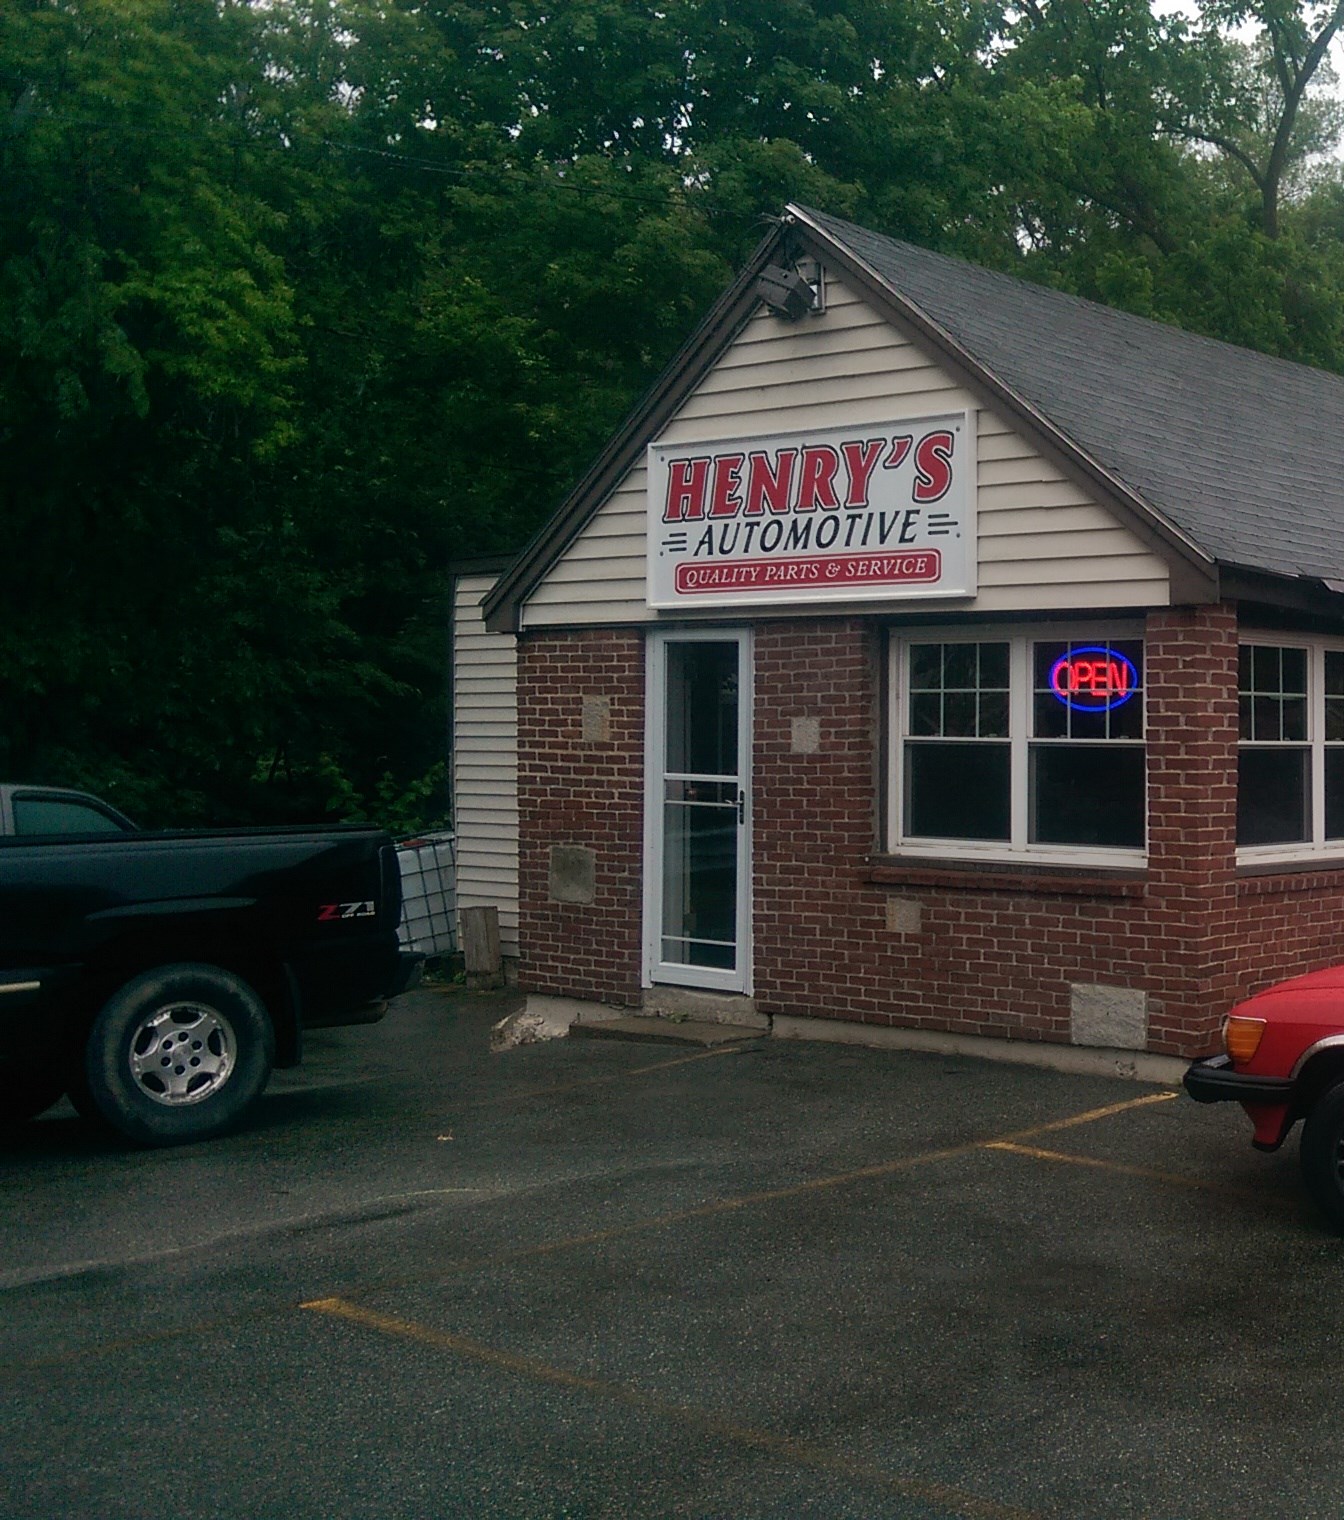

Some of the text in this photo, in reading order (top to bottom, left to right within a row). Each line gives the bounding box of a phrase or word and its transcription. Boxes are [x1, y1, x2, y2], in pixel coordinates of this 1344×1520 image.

[663, 430, 954, 523] HENRY'S
[693, 509, 921, 556] AUTOMOTIVE
[685, 557, 928, 587] QUALITY PARTS & SERVICE
[1052, 660, 1128, 697] OPEN
[318, 901, 375, 920] Z71
